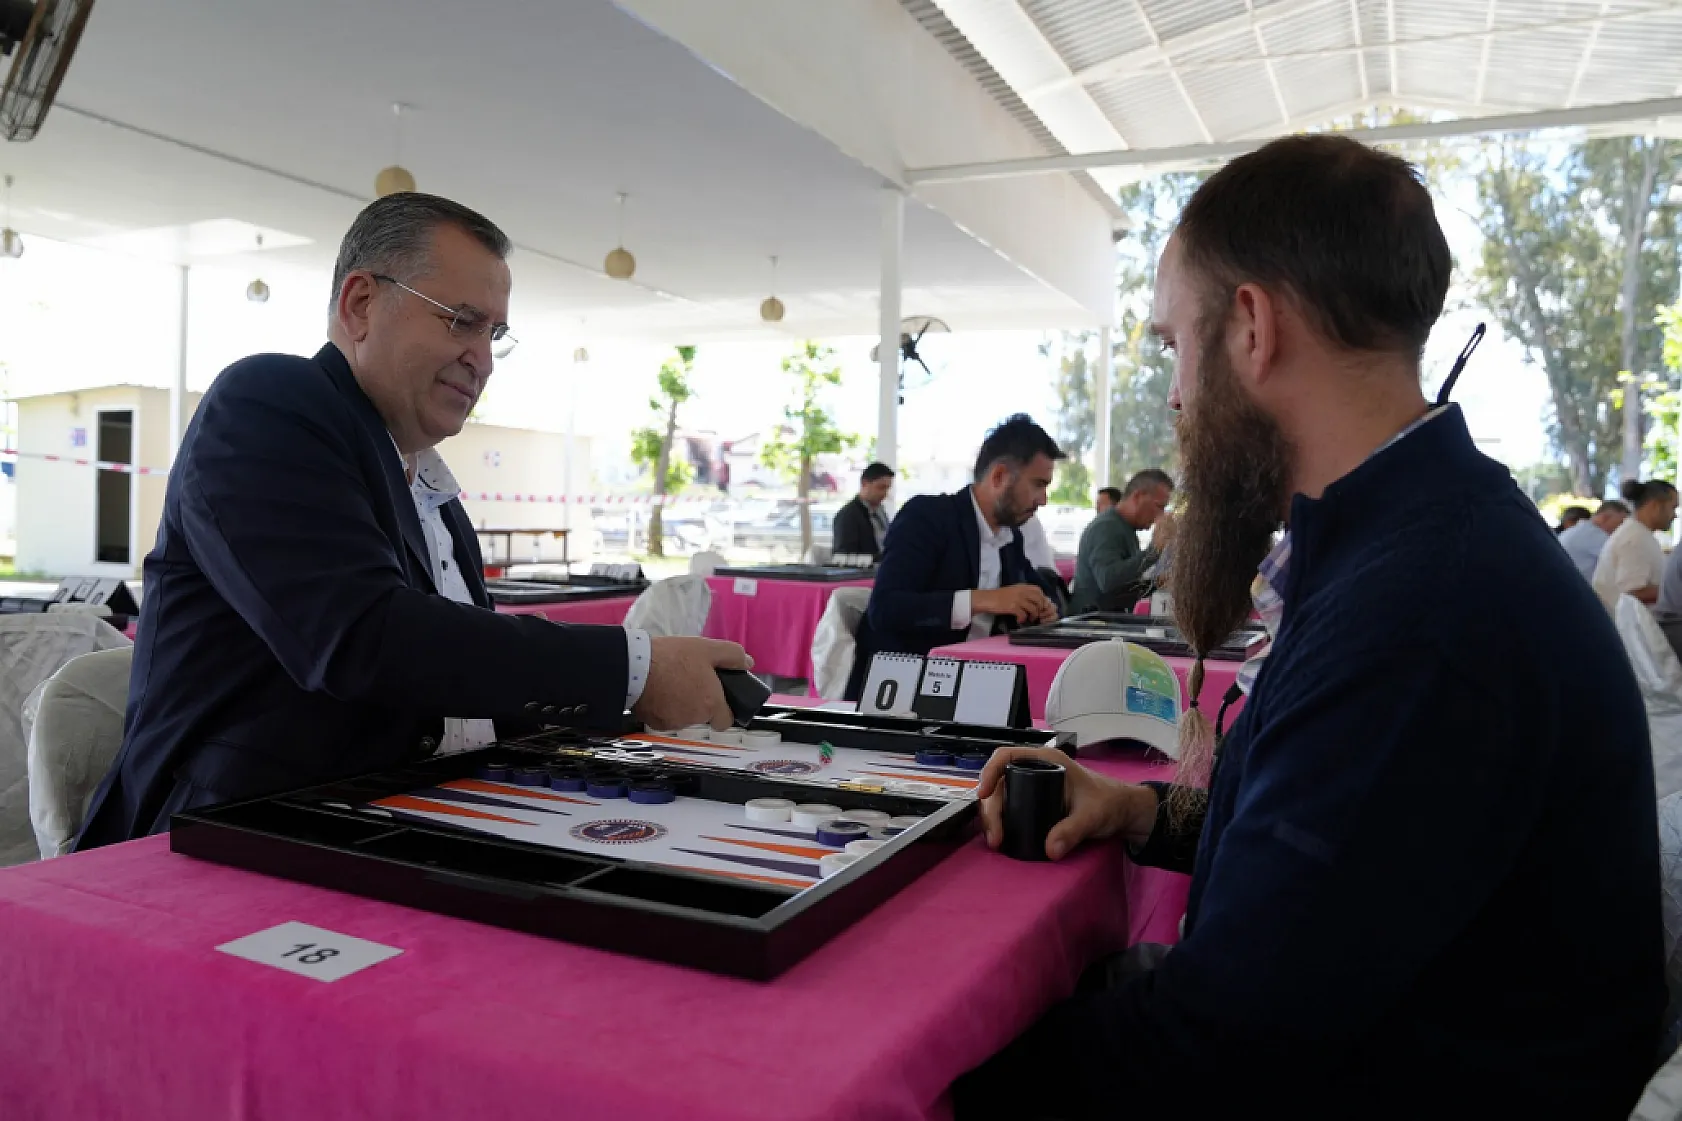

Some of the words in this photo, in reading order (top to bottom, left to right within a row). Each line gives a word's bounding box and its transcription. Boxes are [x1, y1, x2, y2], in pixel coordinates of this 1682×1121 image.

[875, 679, 899, 711] 0
[932, 681, 942, 693] 5
[281, 943, 340, 964] 18
